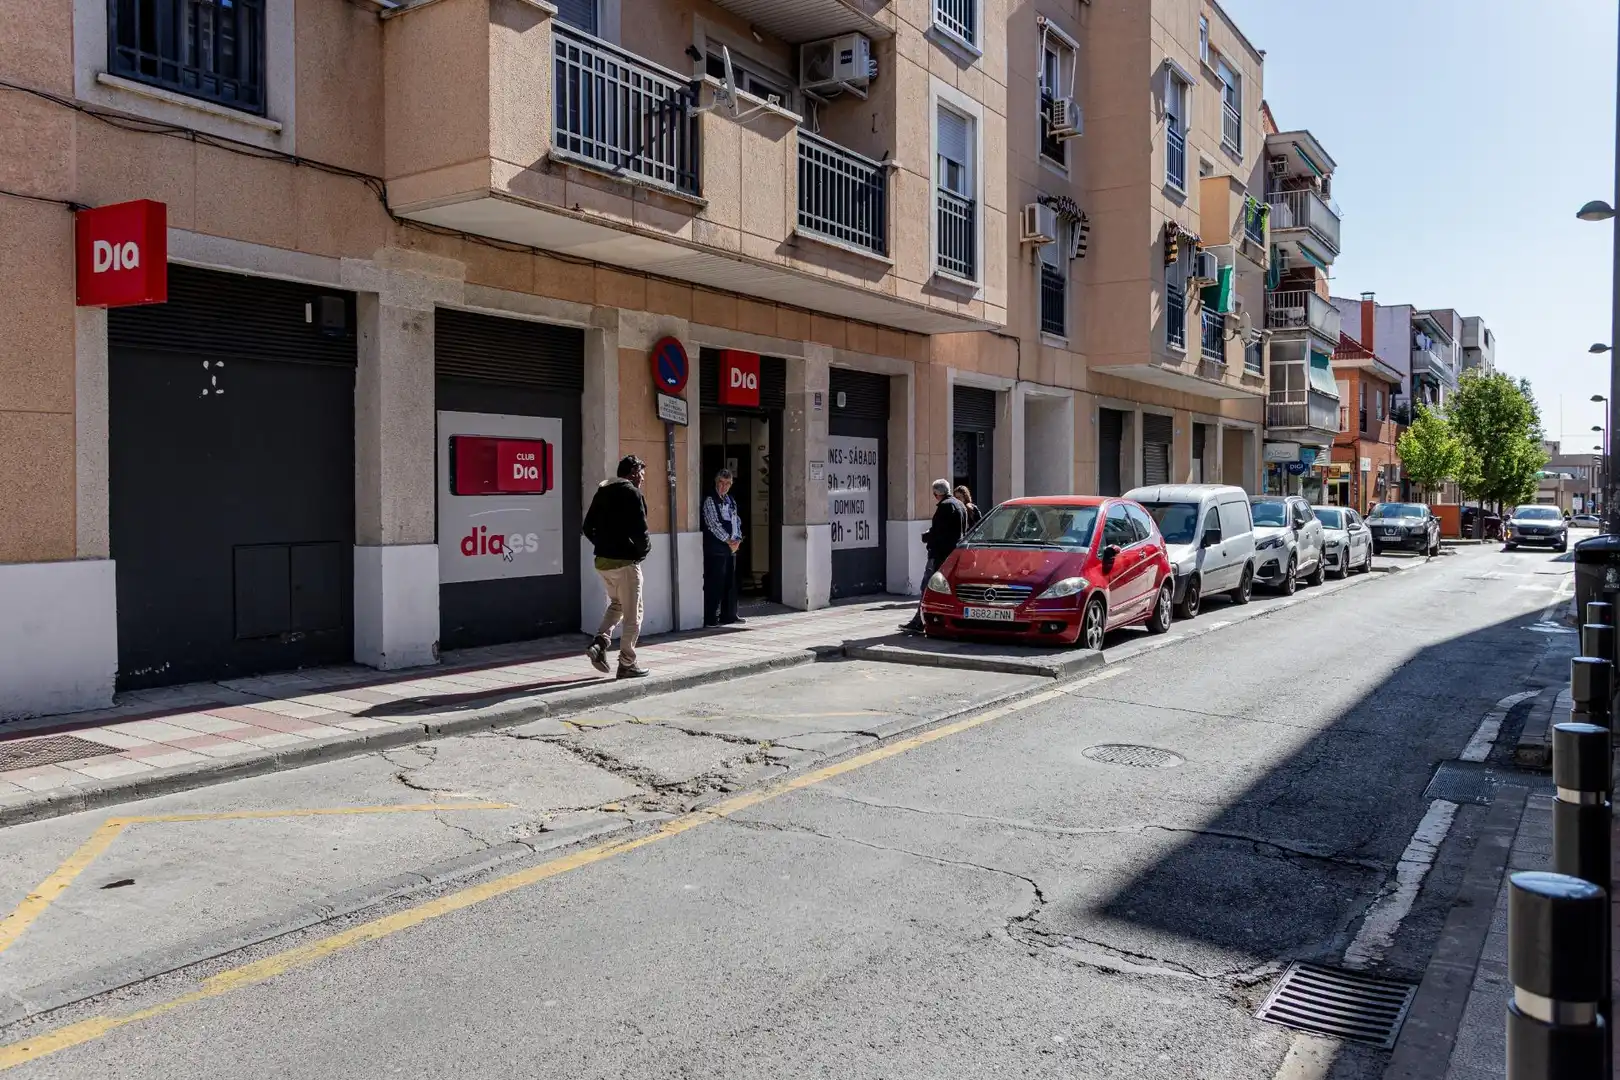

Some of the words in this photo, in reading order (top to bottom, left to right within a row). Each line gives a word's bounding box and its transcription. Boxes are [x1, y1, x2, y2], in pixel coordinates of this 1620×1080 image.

[516, 453, 535, 461] CLUB
[849, 446, 877, 466] SÁBADO
[847, 474, 871, 491] 21:30h
[834, 499, 865, 515] DOMINGO
[829, 521, 843, 543] 0h
[855, 520, 870, 541] 15h
[970, 608, 992, 619] 3682
[994, 609, 1011, 620] FNN
